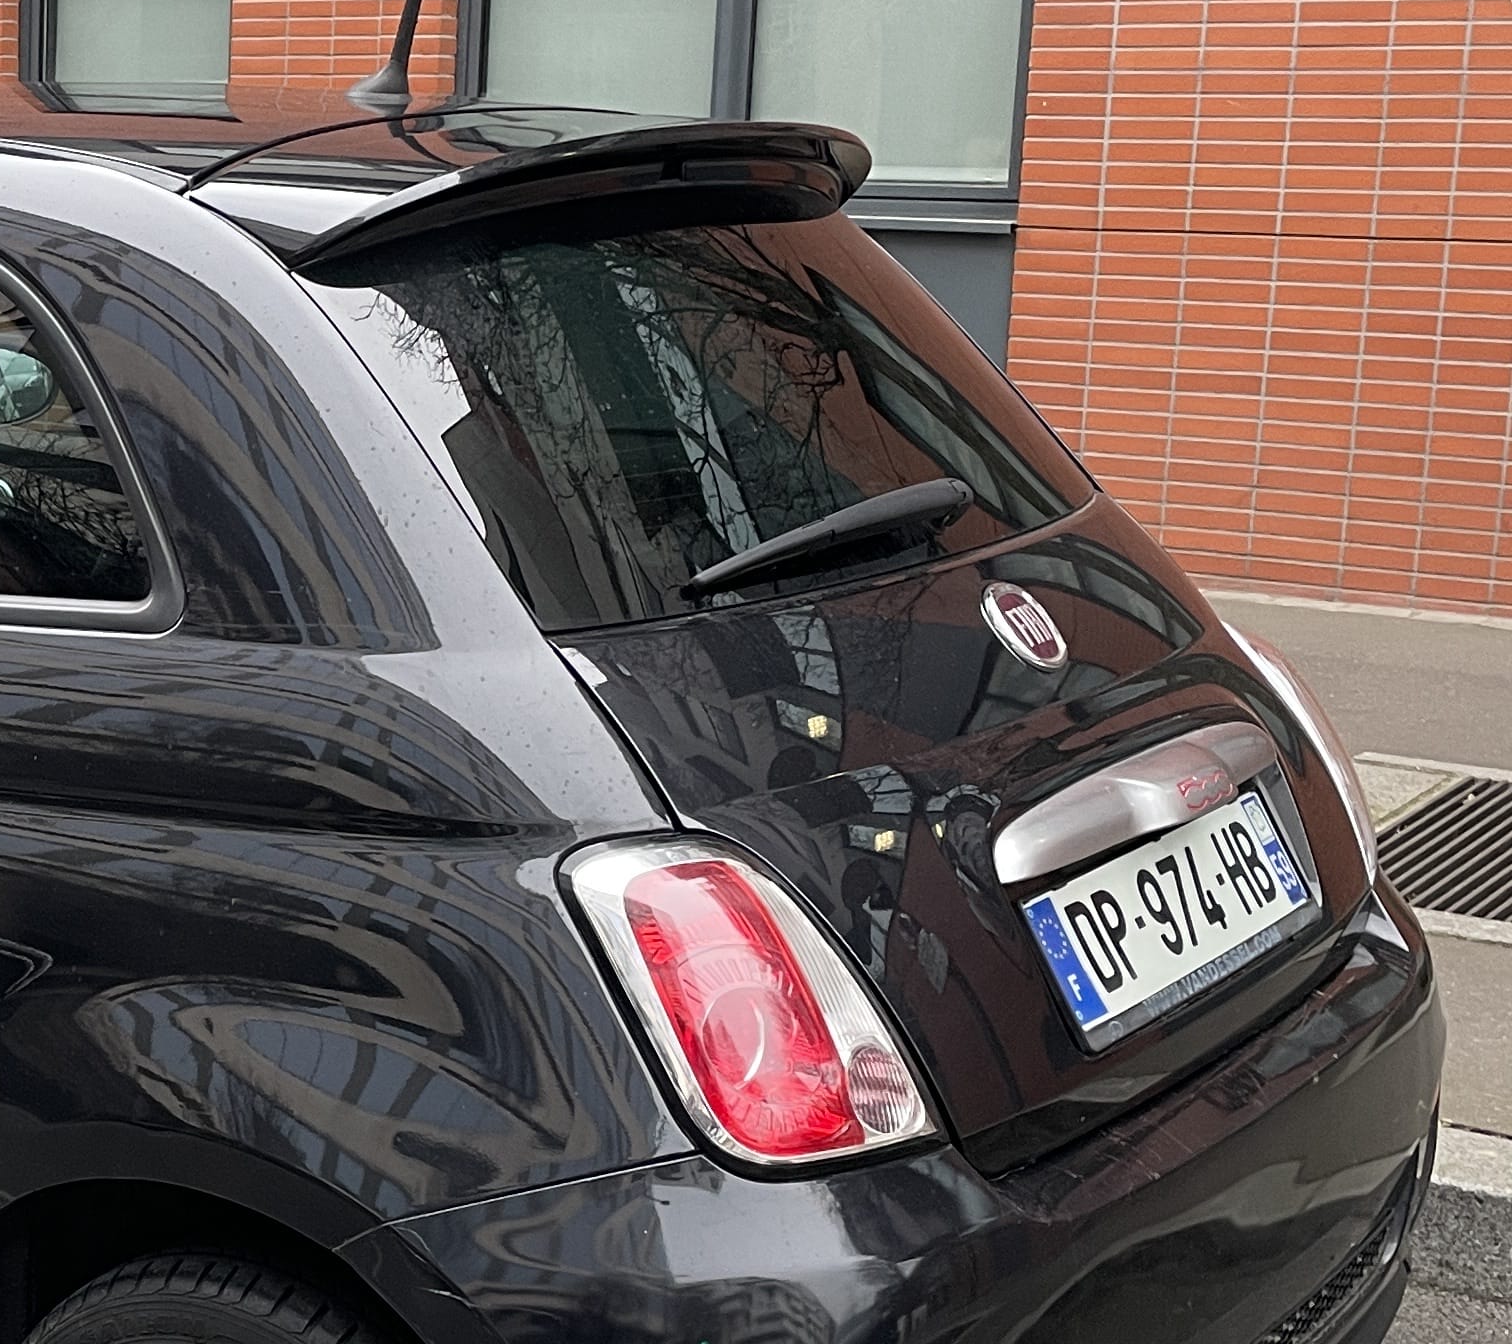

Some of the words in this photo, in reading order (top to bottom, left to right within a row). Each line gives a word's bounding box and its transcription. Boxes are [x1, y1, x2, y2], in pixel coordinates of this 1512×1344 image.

[1004, 603, 1054, 648] FIAT
[1176, 769, 1234, 812] 500
[1266, 850, 1298, 891] 59
[1064, 821, 1277, 994] DP-974-HB
[1066, 973, 1083, 1003] F
